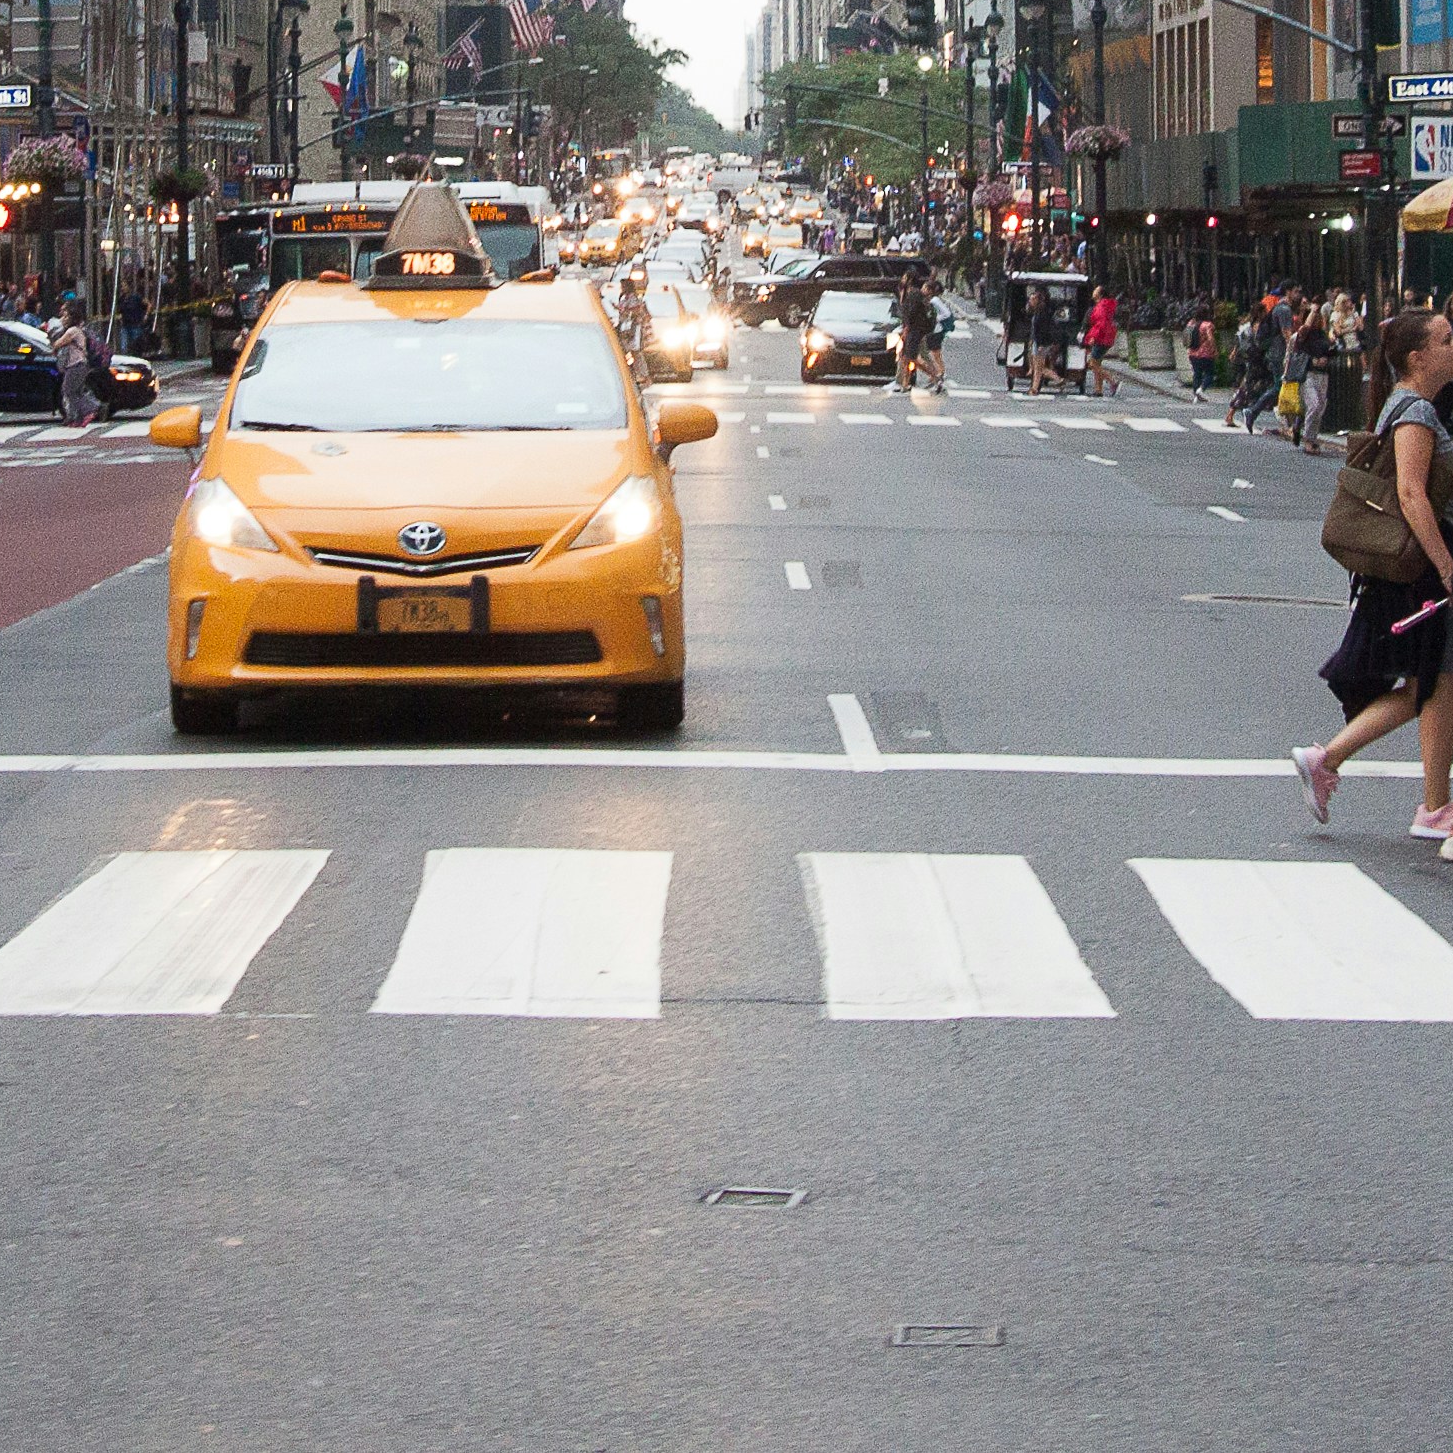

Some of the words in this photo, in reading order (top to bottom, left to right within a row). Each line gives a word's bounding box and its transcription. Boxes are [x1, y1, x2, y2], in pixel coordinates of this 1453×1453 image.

[13, 89, 27, 103] St
[1396, 81, 1429, 97] East
[401, 252, 455, 275] 7M38
